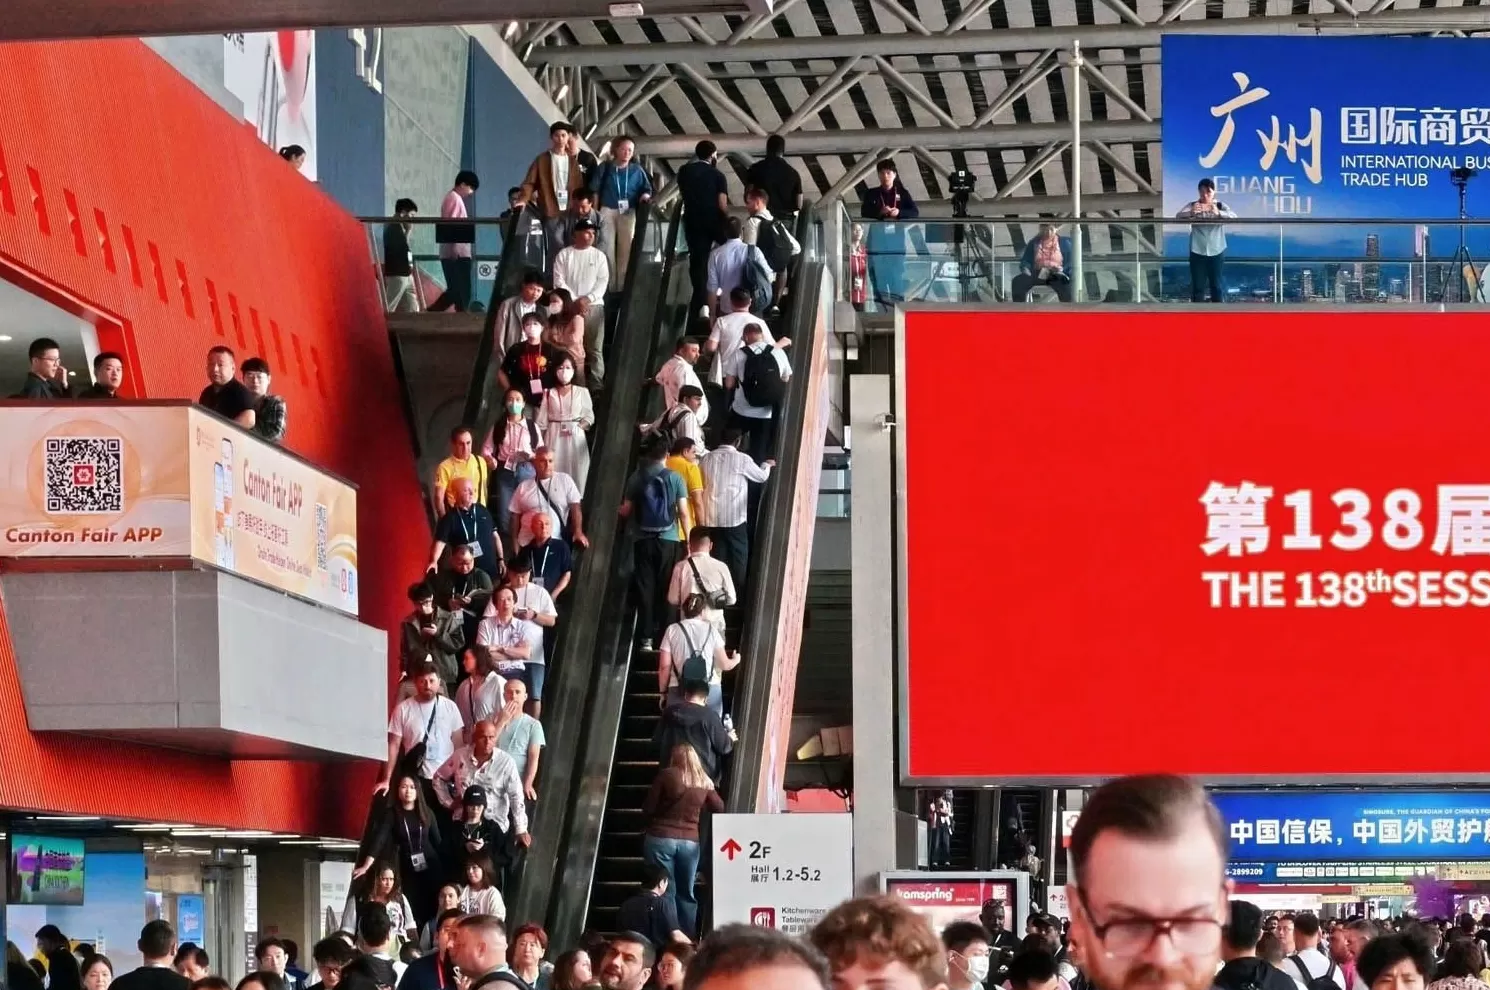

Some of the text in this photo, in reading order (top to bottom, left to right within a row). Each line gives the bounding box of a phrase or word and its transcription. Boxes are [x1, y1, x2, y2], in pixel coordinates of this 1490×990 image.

[1199, 71, 1323, 184] 广州
[1341, 155, 1461, 169] INTERNATIONAL
[1213, 175, 1295, 194] GUANG
[1341, 173, 1428, 186] TRADE HUB
[243, 458, 303, 518] Canton Fair APP
[6, 527, 163, 543] Canton Fair APP
[1202, 571, 1285, 607] THE
[749, 840, 771, 859] 2F
[751, 865, 770, 873] Hall
[773, 866, 821, 881] 1.2-5.2
[751, 874, 769, 883] 展厅
